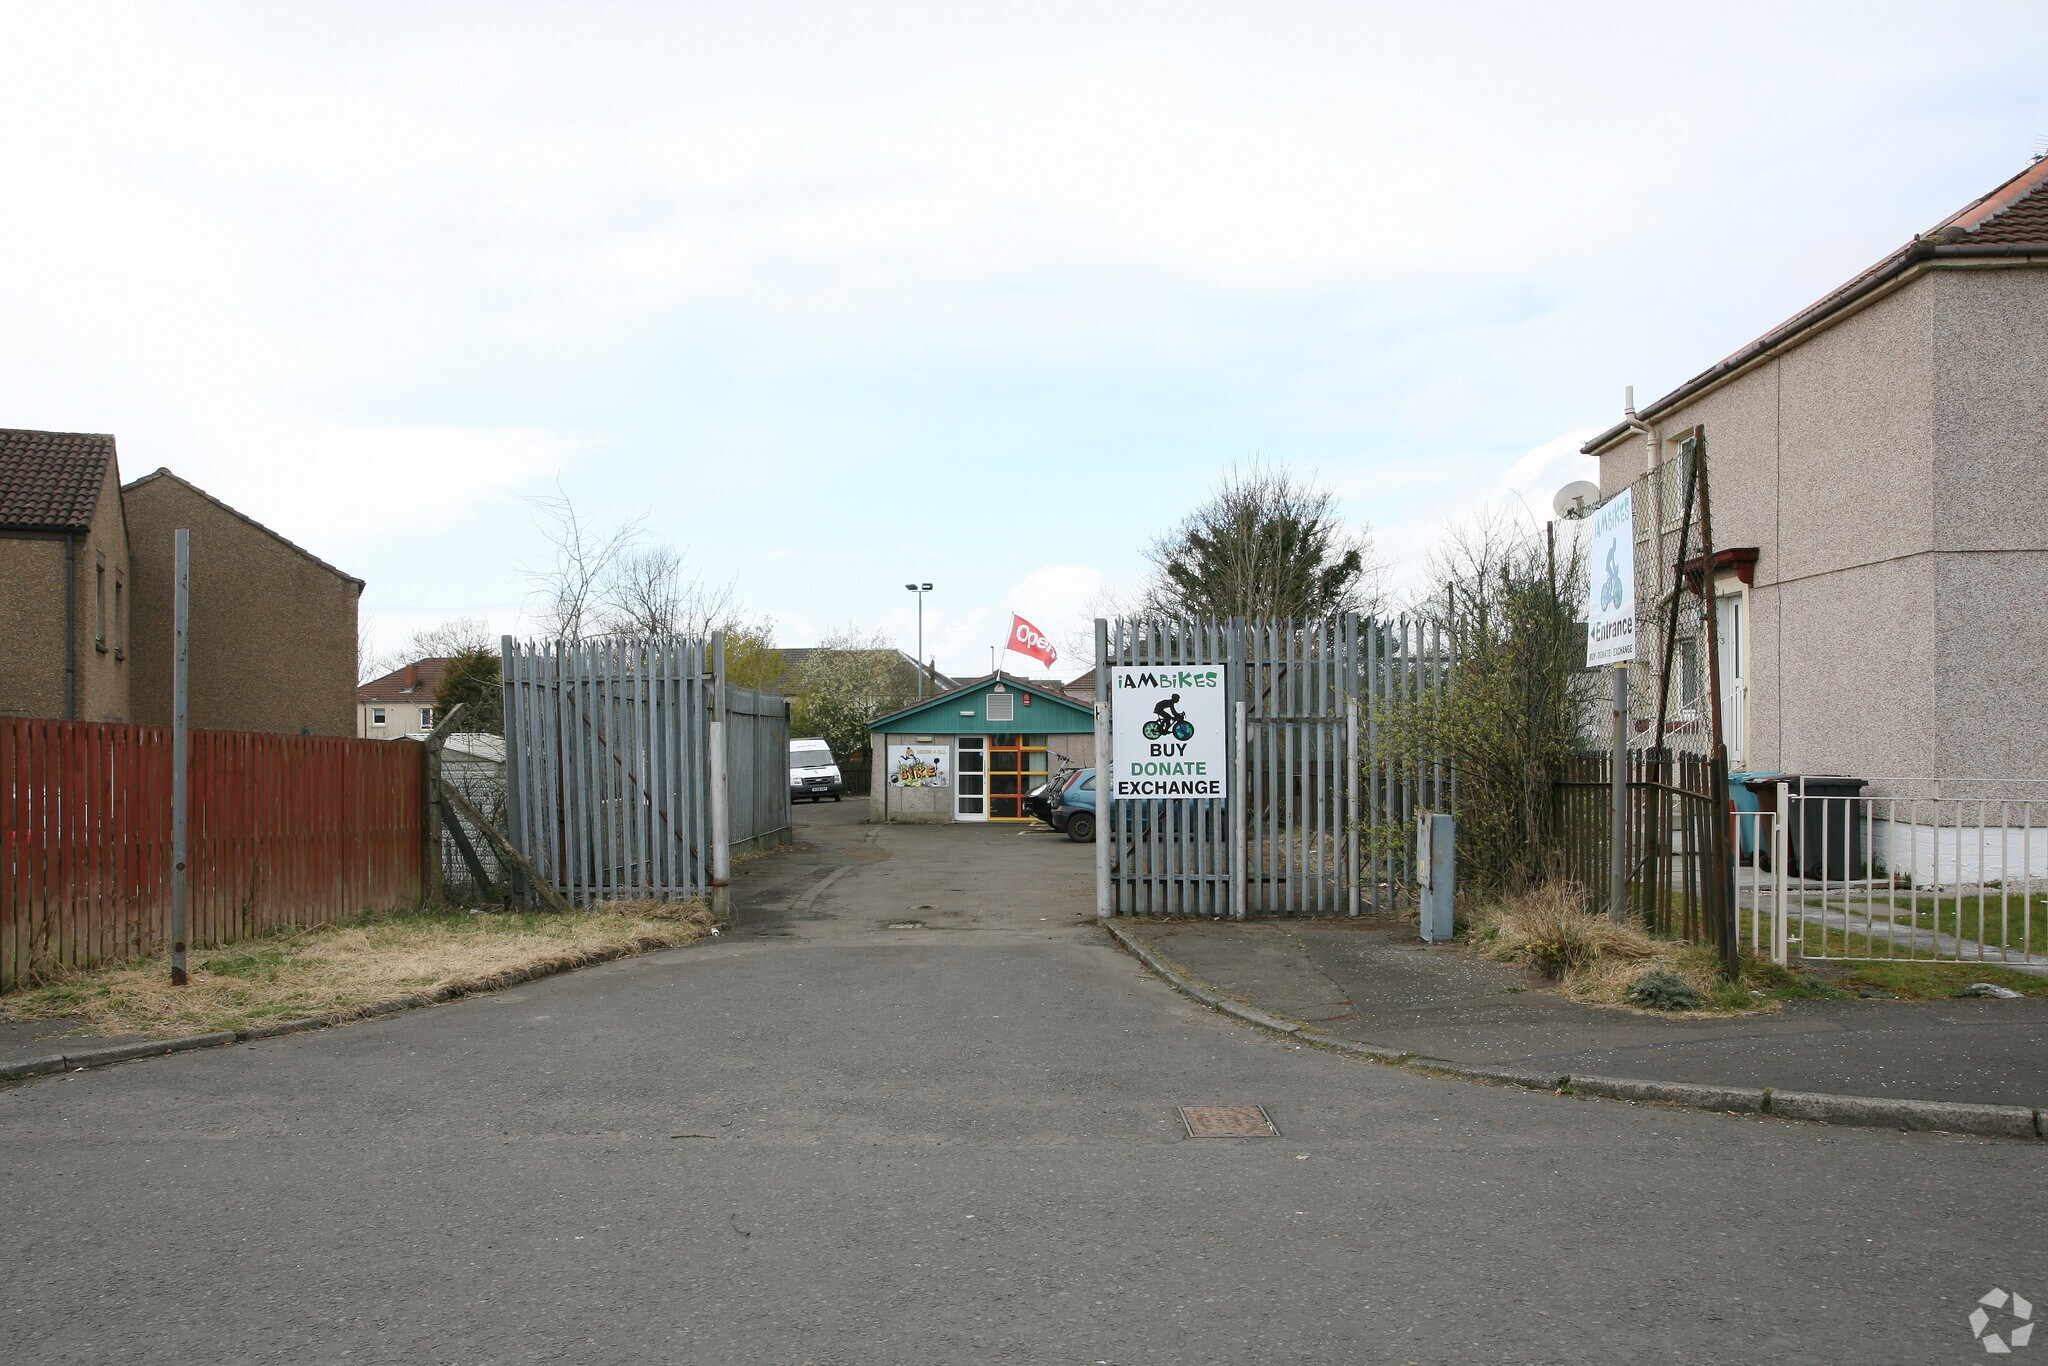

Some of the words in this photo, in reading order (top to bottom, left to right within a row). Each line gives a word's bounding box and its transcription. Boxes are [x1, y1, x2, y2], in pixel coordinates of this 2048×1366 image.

[1595, 616, 1633, 642] Entrance
[1016, 624, 1055, 659] Open
[1613, 644, 1633, 656] EXCHANGE
[1150, 743, 1187, 757] BUY
[900, 765, 937, 780] BIKE
[1131, 762, 1207, 776] DONATE
[1118, 780, 1220, 795] EXCHANGE
